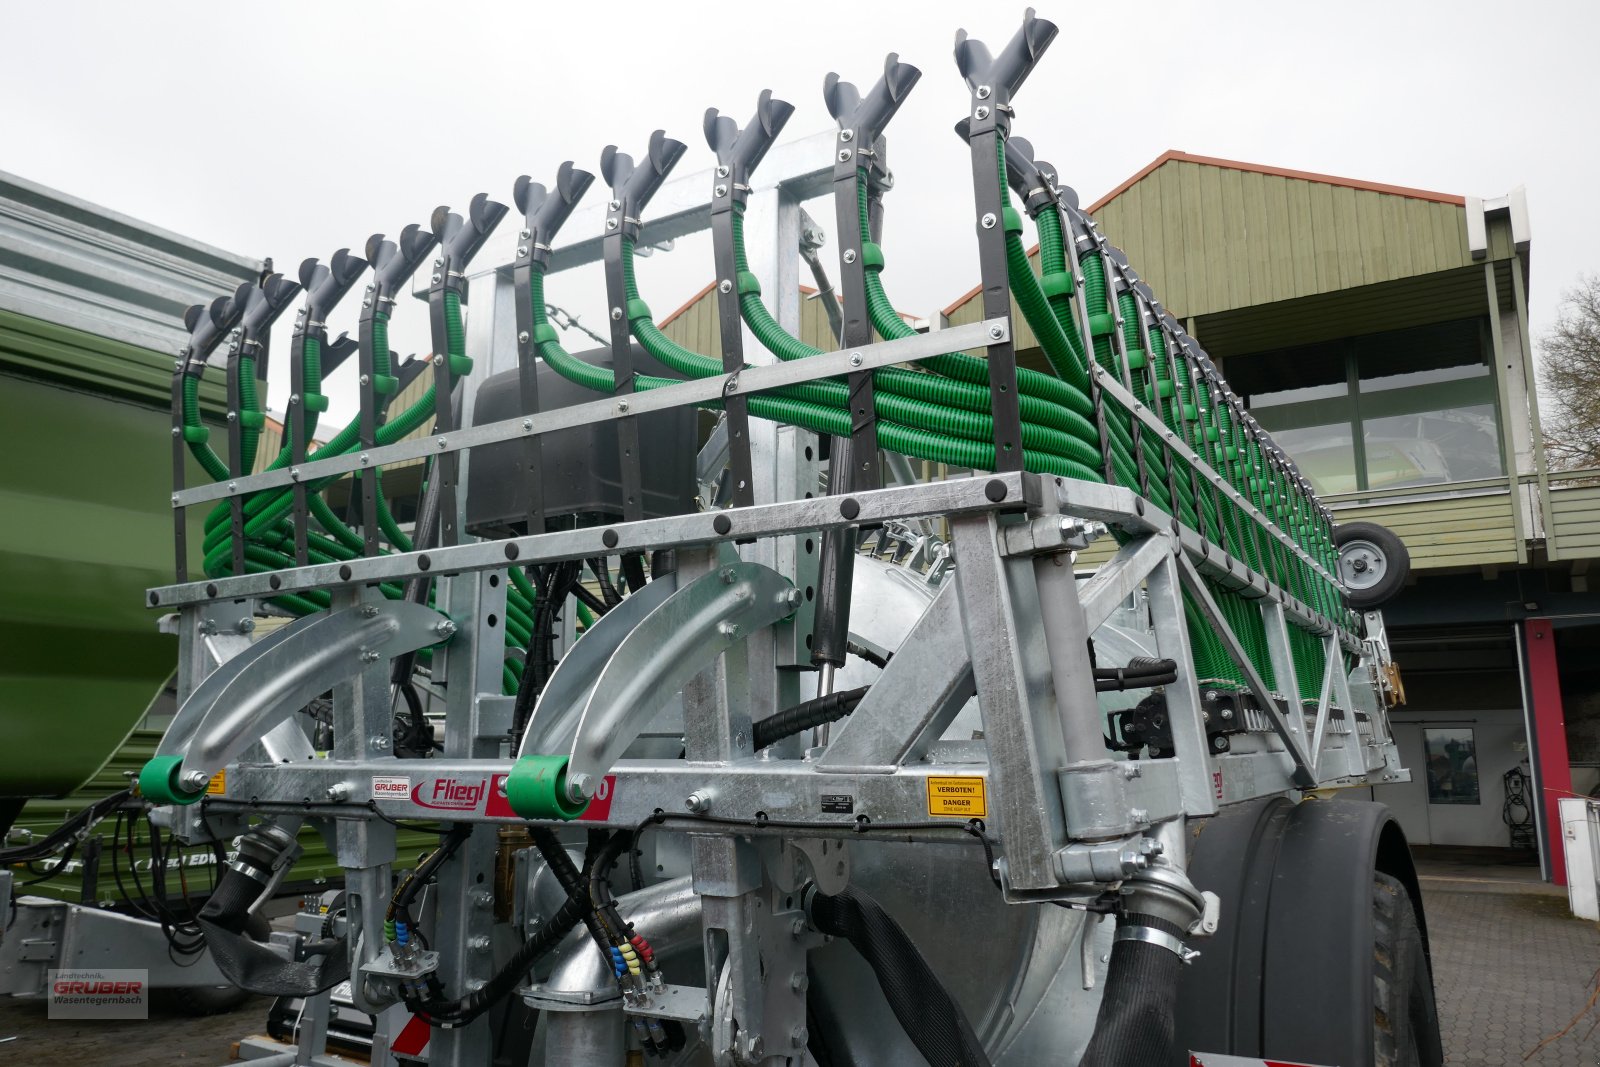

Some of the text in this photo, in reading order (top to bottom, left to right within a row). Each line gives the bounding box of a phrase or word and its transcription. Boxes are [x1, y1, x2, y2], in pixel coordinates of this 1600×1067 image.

[374, 783, 408, 792] GRUBER
[433, 778, 487, 806] Fliegl
[937, 786, 975, 794] VERBOTEN!
